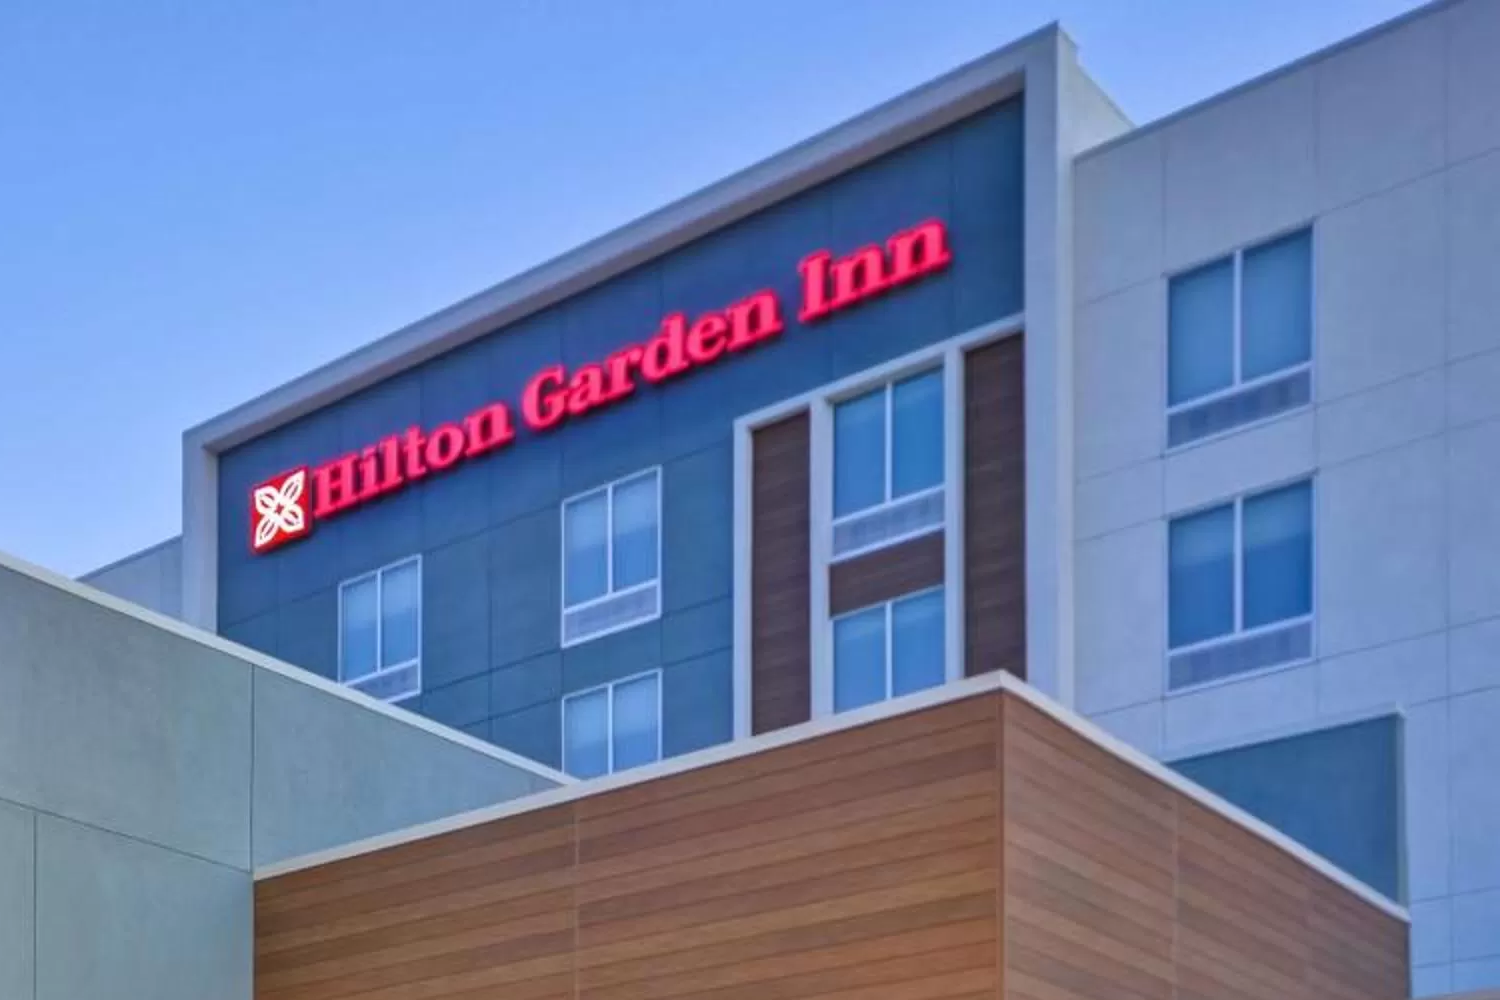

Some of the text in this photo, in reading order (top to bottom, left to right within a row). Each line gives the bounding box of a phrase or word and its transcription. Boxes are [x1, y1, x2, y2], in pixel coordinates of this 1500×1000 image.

[309, 219, 950, 518] Hilton Garden Inn
